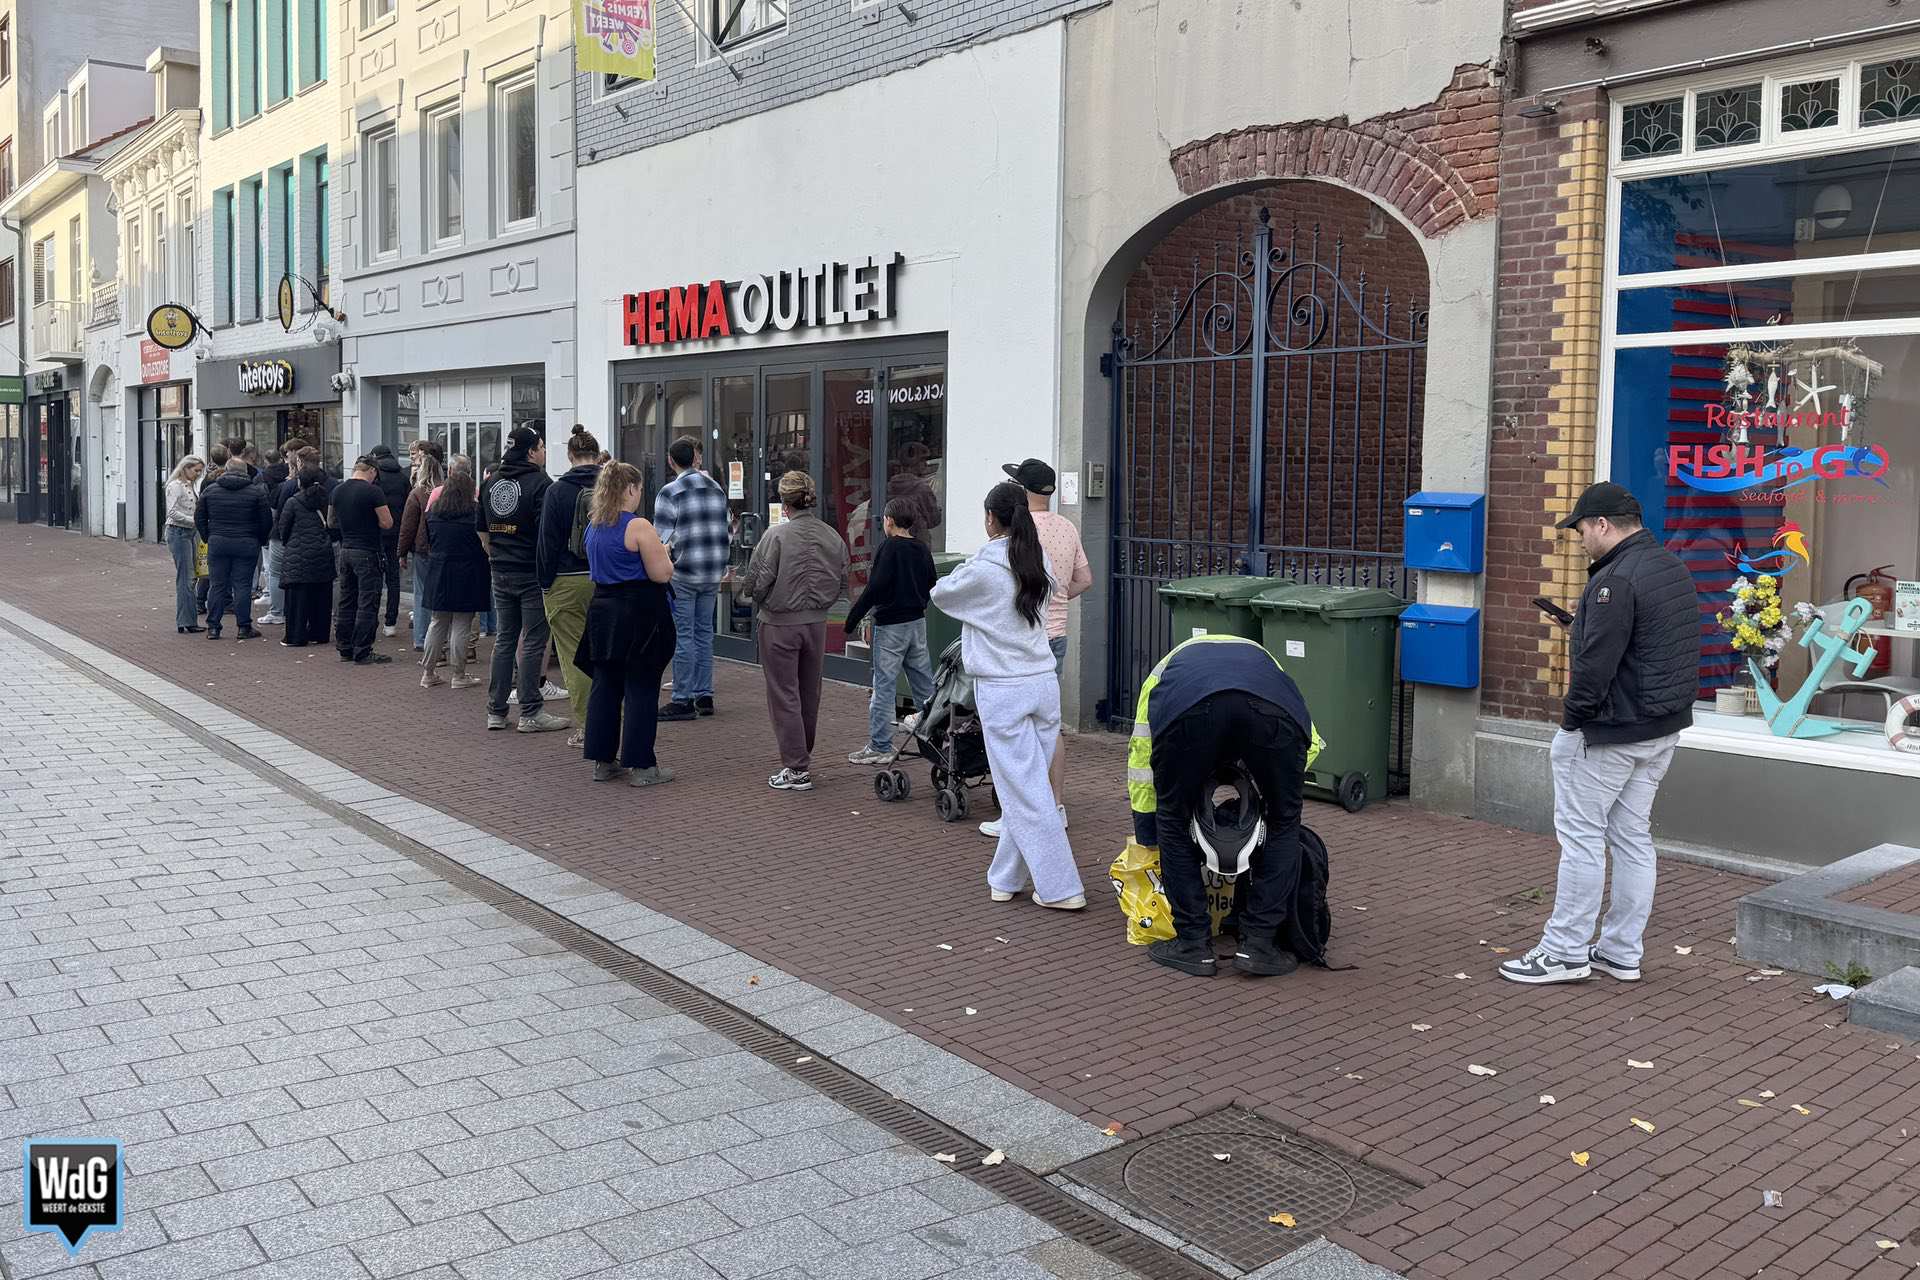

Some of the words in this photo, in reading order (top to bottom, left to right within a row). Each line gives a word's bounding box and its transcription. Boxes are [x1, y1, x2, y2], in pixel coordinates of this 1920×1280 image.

[623, 280, 731, 346] HEMA
[737, 252, 904, 334] OUTLET
[238, 364, 284, 392] Intertoys
[1703, 403, 1850, 429] Restaurant
[1668, 445, 1764, 478] FISH
[1813, 444, 1890, 479] GO
